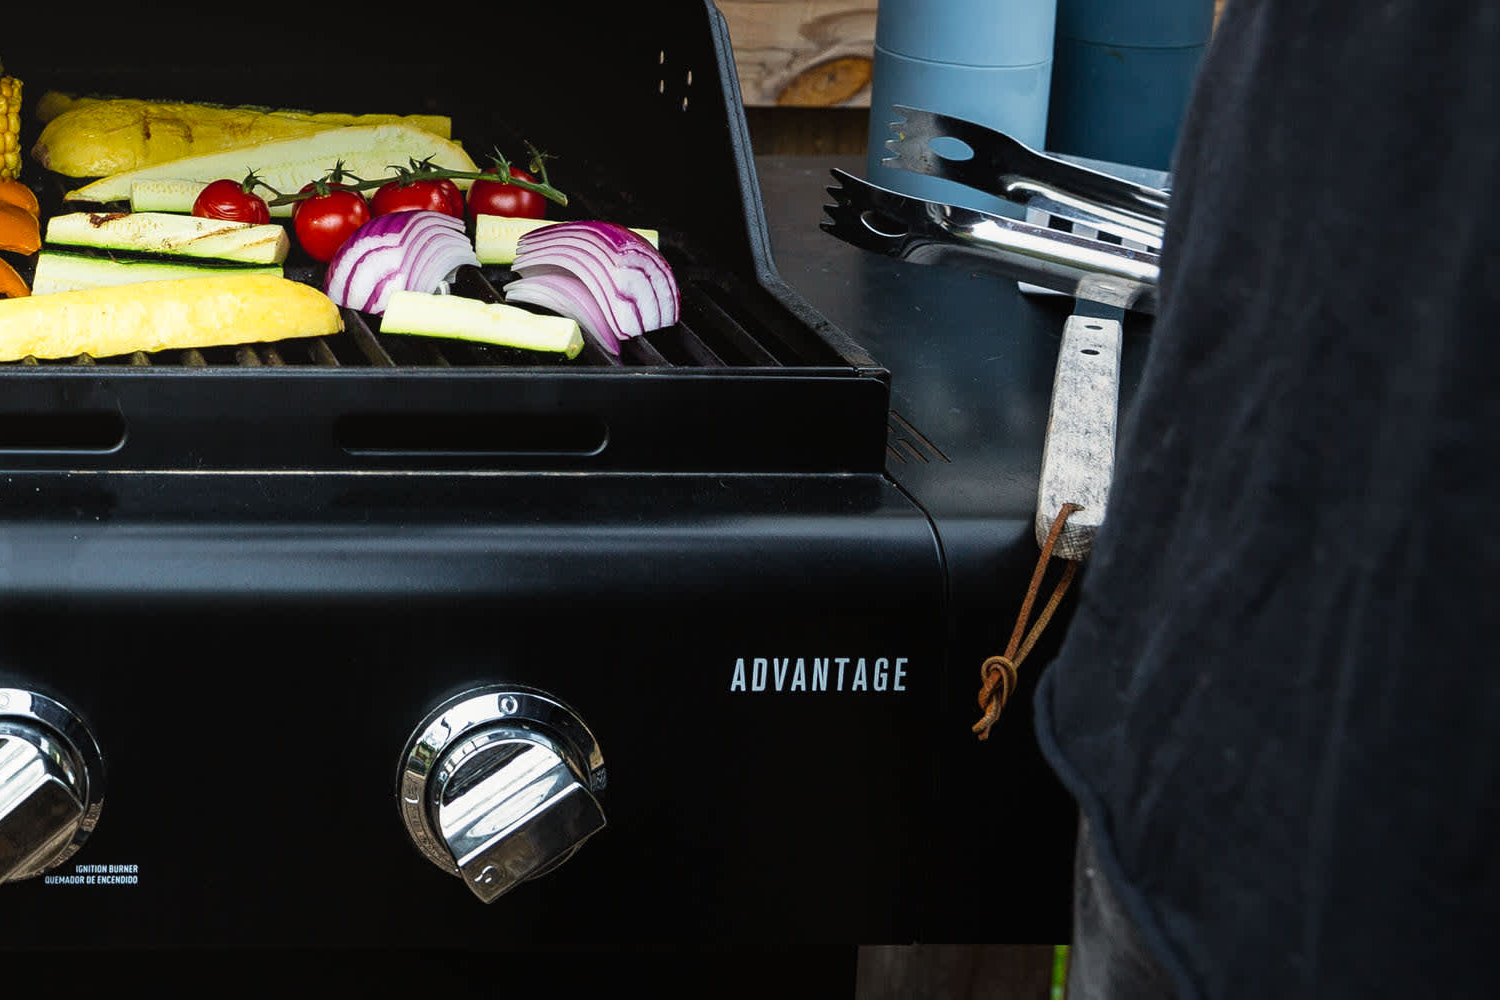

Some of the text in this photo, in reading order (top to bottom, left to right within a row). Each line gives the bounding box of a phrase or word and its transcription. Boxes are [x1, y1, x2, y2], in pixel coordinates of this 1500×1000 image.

[730, 657, 909, 692] ADVANTAGE
[75, 864, 139, 873] IGNITION BURNER
[44, 875, 138, 885] QUEMADOR DE ENCENDIDO
